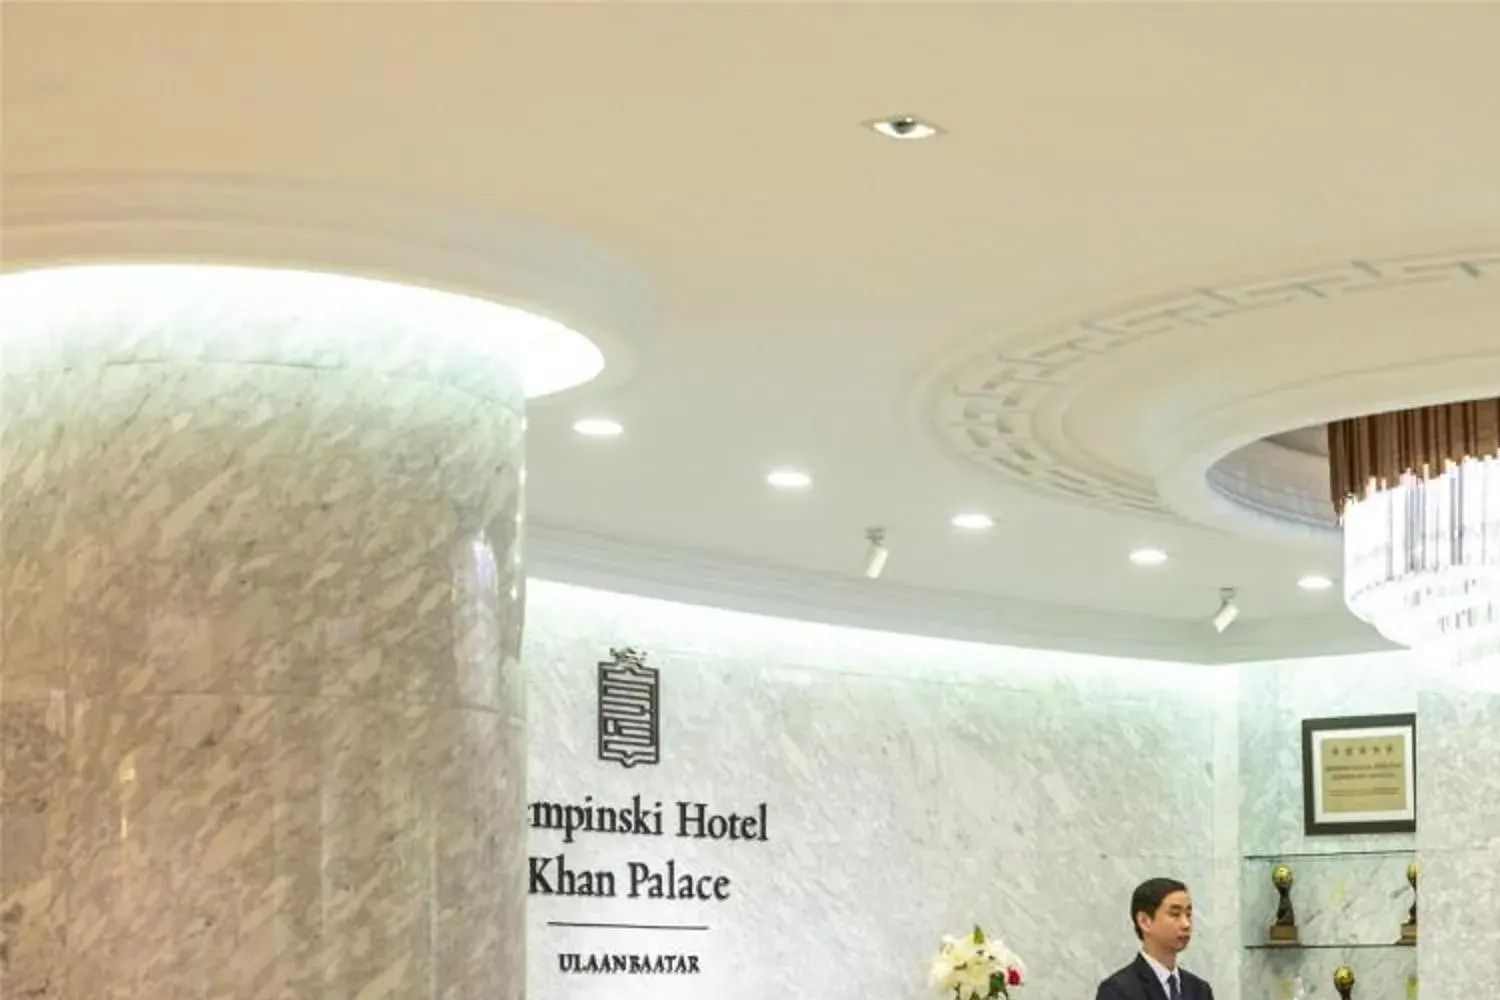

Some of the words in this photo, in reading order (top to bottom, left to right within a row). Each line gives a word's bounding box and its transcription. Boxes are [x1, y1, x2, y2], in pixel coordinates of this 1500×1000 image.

[528, 793, 664, 843] mpinski
[676, 801, 769, 841] Hotel
[528, 854, 617, 897] Khan
[627, 859, 731, 901] Palace
[558, 953, 701, 974] ULAANBAATAR
